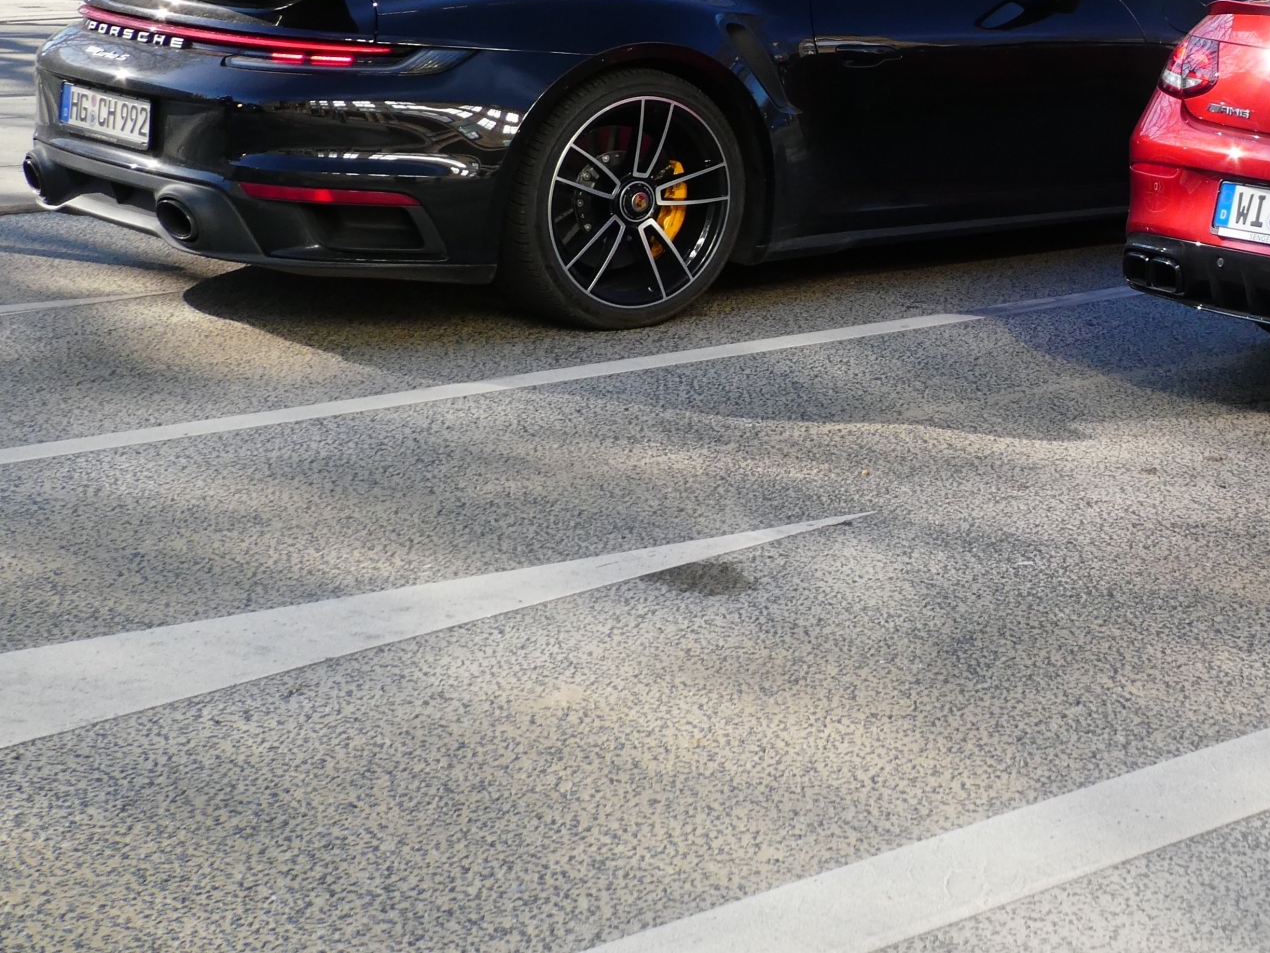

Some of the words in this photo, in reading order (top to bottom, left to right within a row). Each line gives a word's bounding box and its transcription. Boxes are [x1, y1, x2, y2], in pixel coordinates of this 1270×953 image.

[88, 21, 184, 49] PORSCHE
[70, 90, 89, 123] HG
[97, 97, 118, 130] CH
[120, 103, 148, 137] 992
[1219, 209, 1227, 219] D
[1235, 191, 1266, 228] WI
